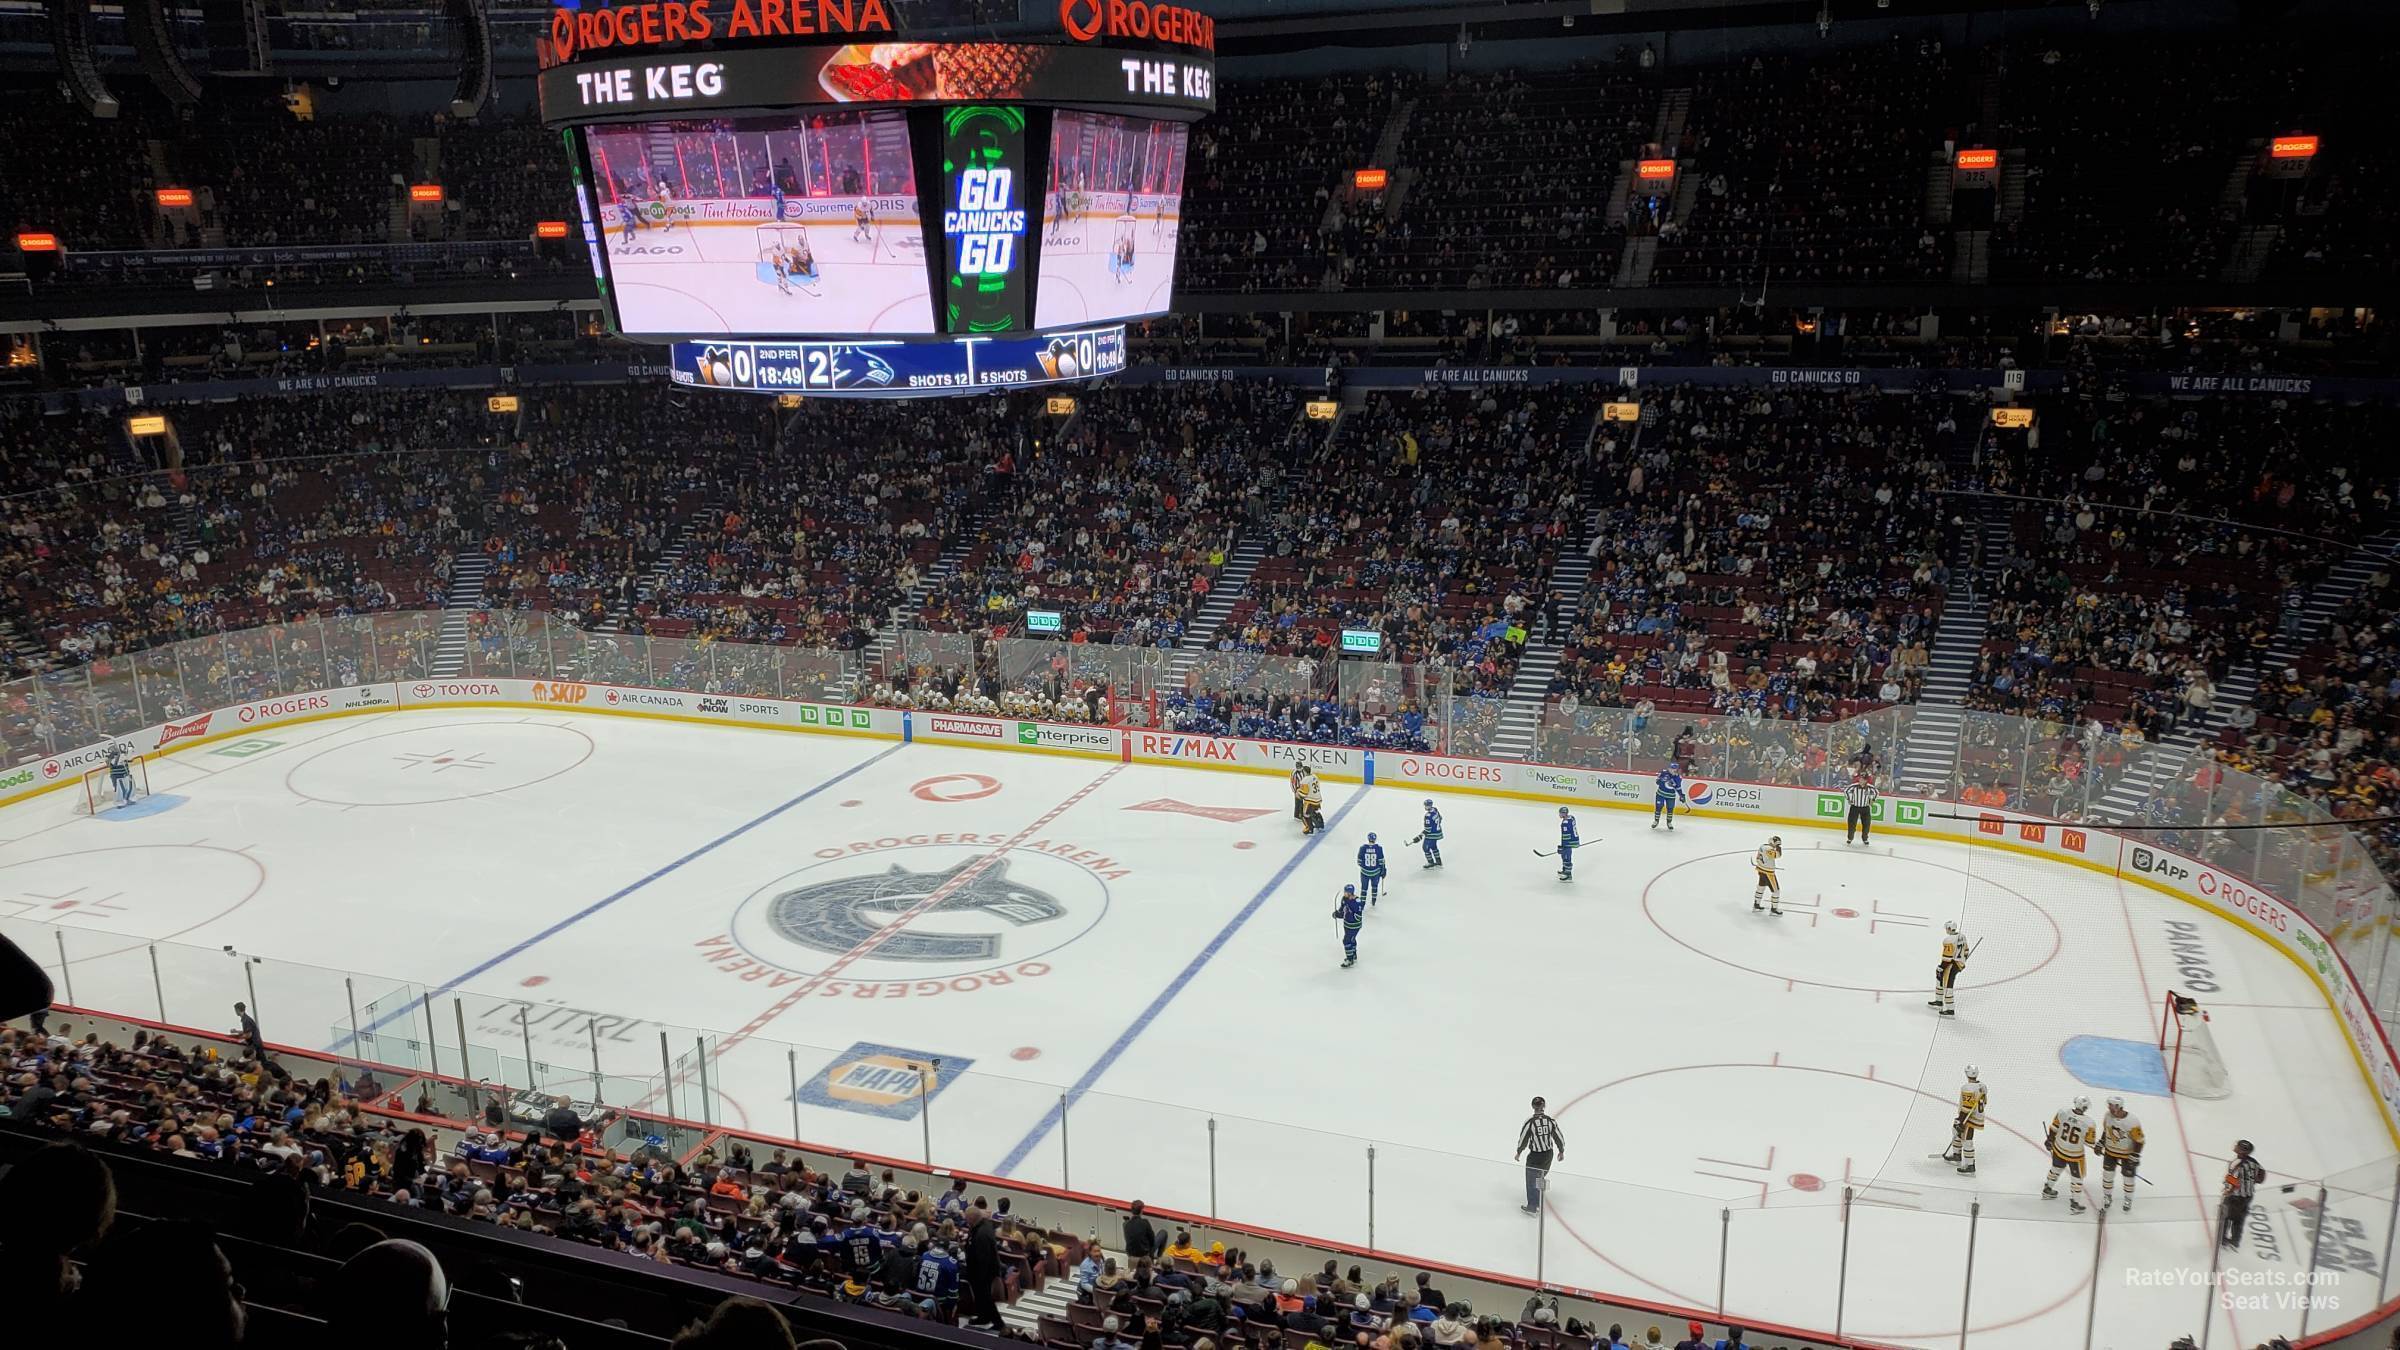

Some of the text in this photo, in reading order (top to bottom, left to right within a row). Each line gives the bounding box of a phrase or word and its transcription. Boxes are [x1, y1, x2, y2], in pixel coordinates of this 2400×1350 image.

[578, 0, 892, 50] ROGERS ARENA
[1108, 0, 1202, 45] ROGERS
[577, 64, 722, 105] THE KEG
[1121, 58, 1210, 99] THE KEG
[958, 168, 1012, 211] GO
[701, 203, 773, 219] Tim Hortons
[807, 202, 854, 214] Supreme
[944, 211, 1024, 232] CANUCKS
[959, 233, 1013, 274] GO
[759, 350, 799, 360] 2ND PER
[1080, 339, 1092, 370] 0
[628, 365, 669, 376] GO CANUC
[734, 350, 750, 383] 0
[758, 366, 801, 385] 18:49
[808, 351, 829, 385] 2
[1165, 369, 1234, 381] GO CANUCKS GO
[278, 379, 294, 392] WE
[295, 377, 313, 390] ARE
[334, 375, 378, 388] CANUCKS
[909, 374, 968, 387] SHOTS 12
[980, 370, 1028, 384] 5 SHOTS
[1424, 370, 1529, 382] WE ARE ALL CANUCKS
[1771, 370, 1860, 384] GO CANUCKS GO
[2007, 373, 2022, 384] 119
[2170, 376, 2312, 393] WE ARE ALL CANUCKS
[438, 684, 500, 696] TOYOTA
[550, 682, 587, 704] SKIP
[260, 695, 329, 718] ROGERS
[621, 693, 684, 707] AIR CANADA
[702, 697, 728, 706] PLAY
[739, 703, 779, 715] SPORTS
[703, 705, 729, 714] NOW
[802, 707, 869, 725] TD TD TD
[163, 722, 209, 741] Budweiser
[933, 719, 1001, 736] PHARMASAVE
[1020, 727, 1110, 745] enterprise
[63, 740, 135, 769] AIR CANDA
[1142, 734, 1237, 761] RE/MAX
[1272, 745, 1348, 765] FASKEN
[1425, 762, 1502, 782] ROGERS
[1535, 772, 1578, 786] NexGen
[1552, 783, 1577, 793] Energy
[1597, 779, 1640, 792] NexGen
[1613, 790, 1640, 799] Energy
[1716, 787, 1761, 801] pepsi
[1734, 801, 1760, 810] SUGAR
[1823, 799, 1843, 813] TD
[1899, 805, 1922, 820] TD
[848, 833, 1132, 881] ROGERS ARENA
[1364, 853, 1377, 866] 88
[2221, 883, 2288, 933] ROGERS
[2163, 919, 2222, 993] PANAGO
[694, 934, 1014, 999] ROGERS ARENA
[840, 1064, 921, 1095] NAPA
[2062, 1122, 2082, 1145] 26
[918, 1266, 939, 1292] 53
